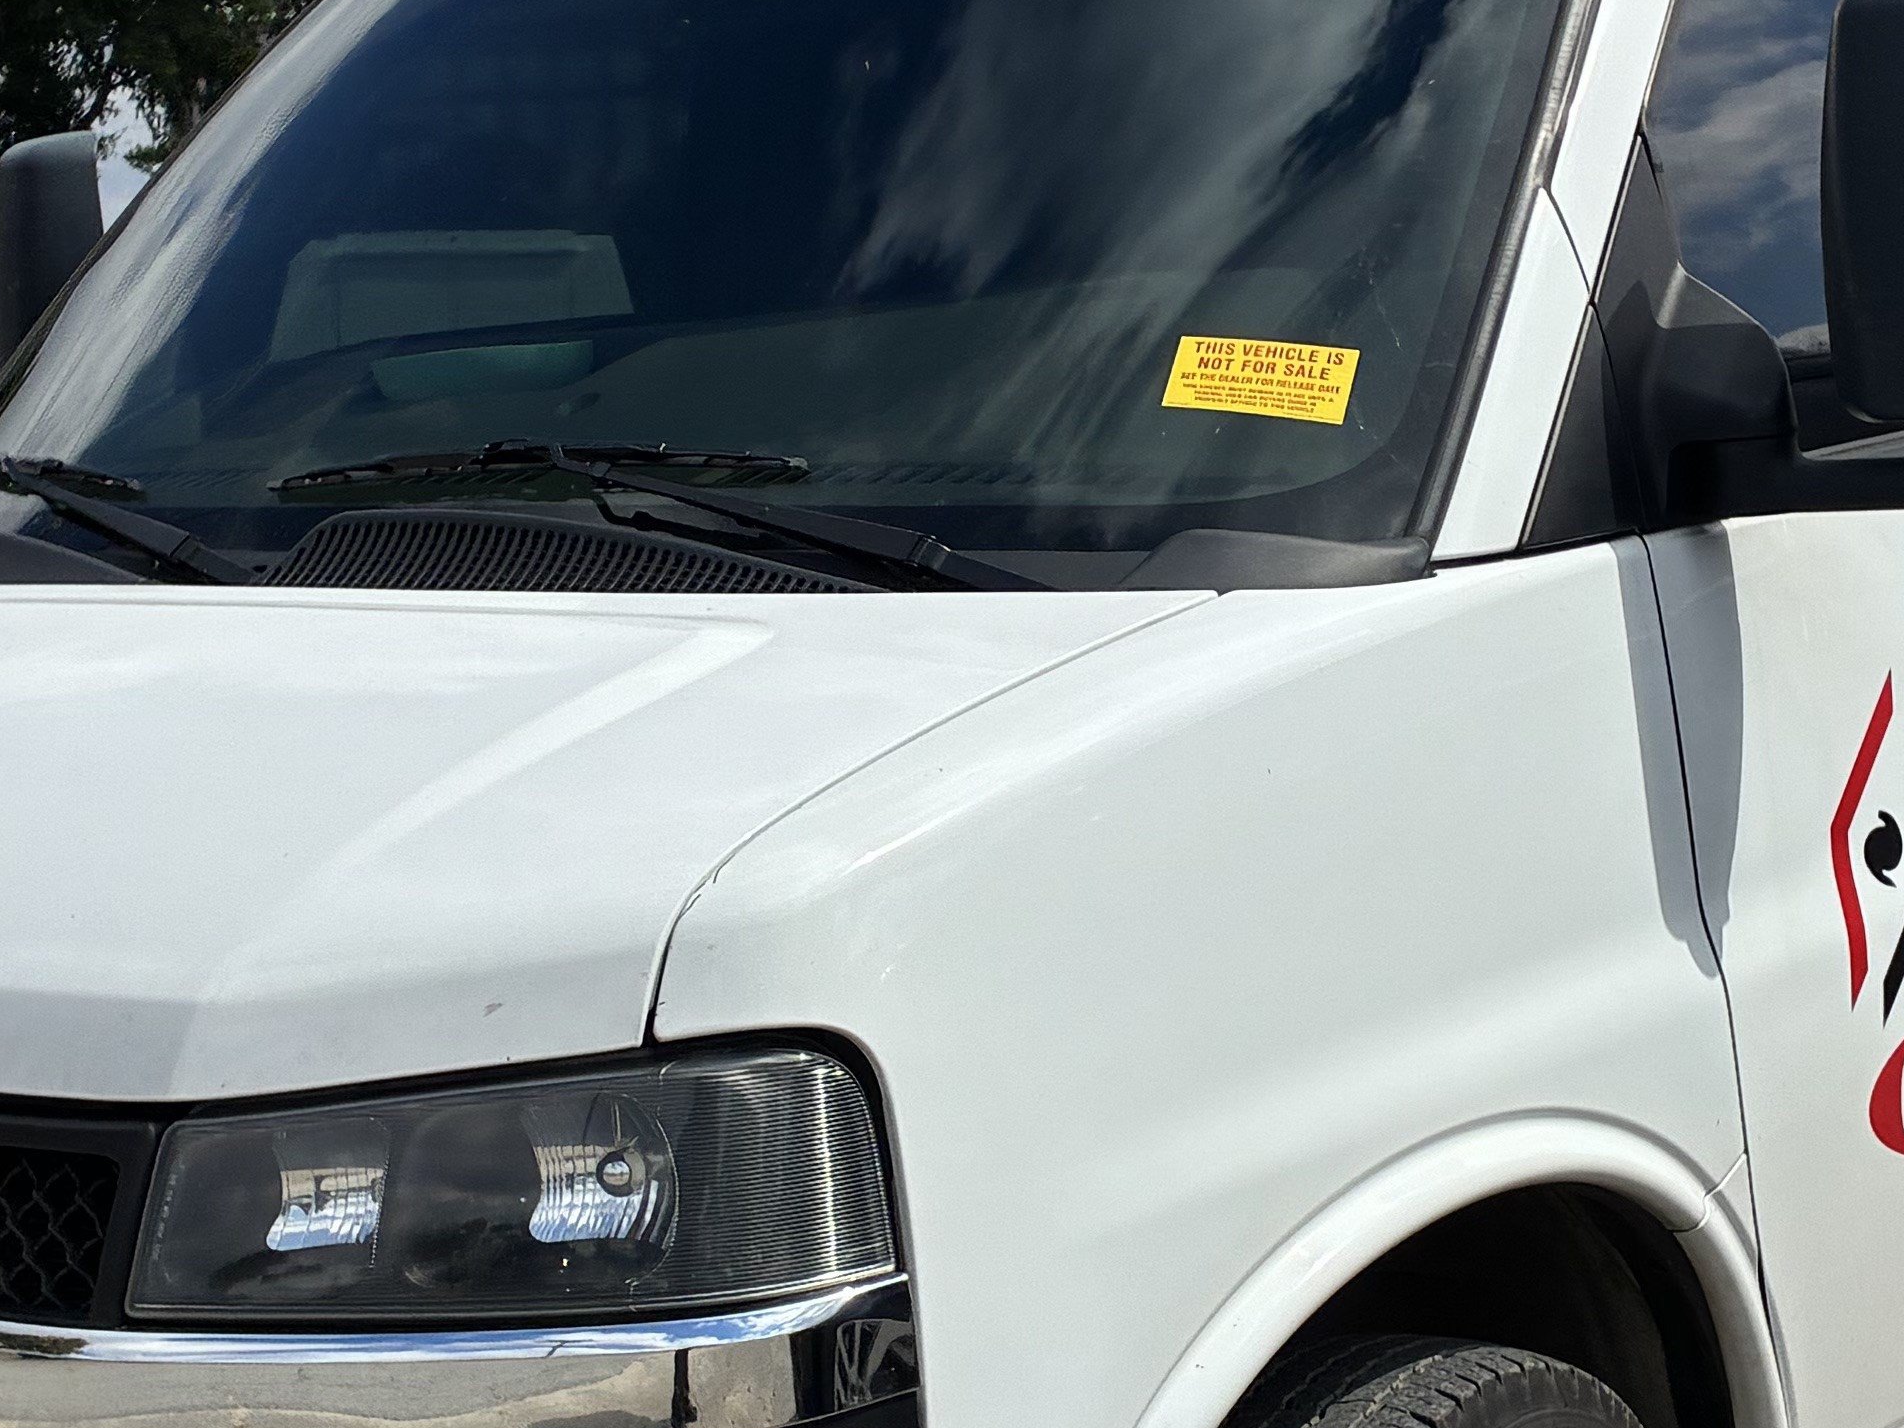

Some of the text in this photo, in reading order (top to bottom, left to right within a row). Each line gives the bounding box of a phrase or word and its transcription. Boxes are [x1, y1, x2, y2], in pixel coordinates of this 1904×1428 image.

[1195, 341, 1345, 365] THIS VEHICLE IS
[1198, 356, 1331, 381] NOT FOR SALE
